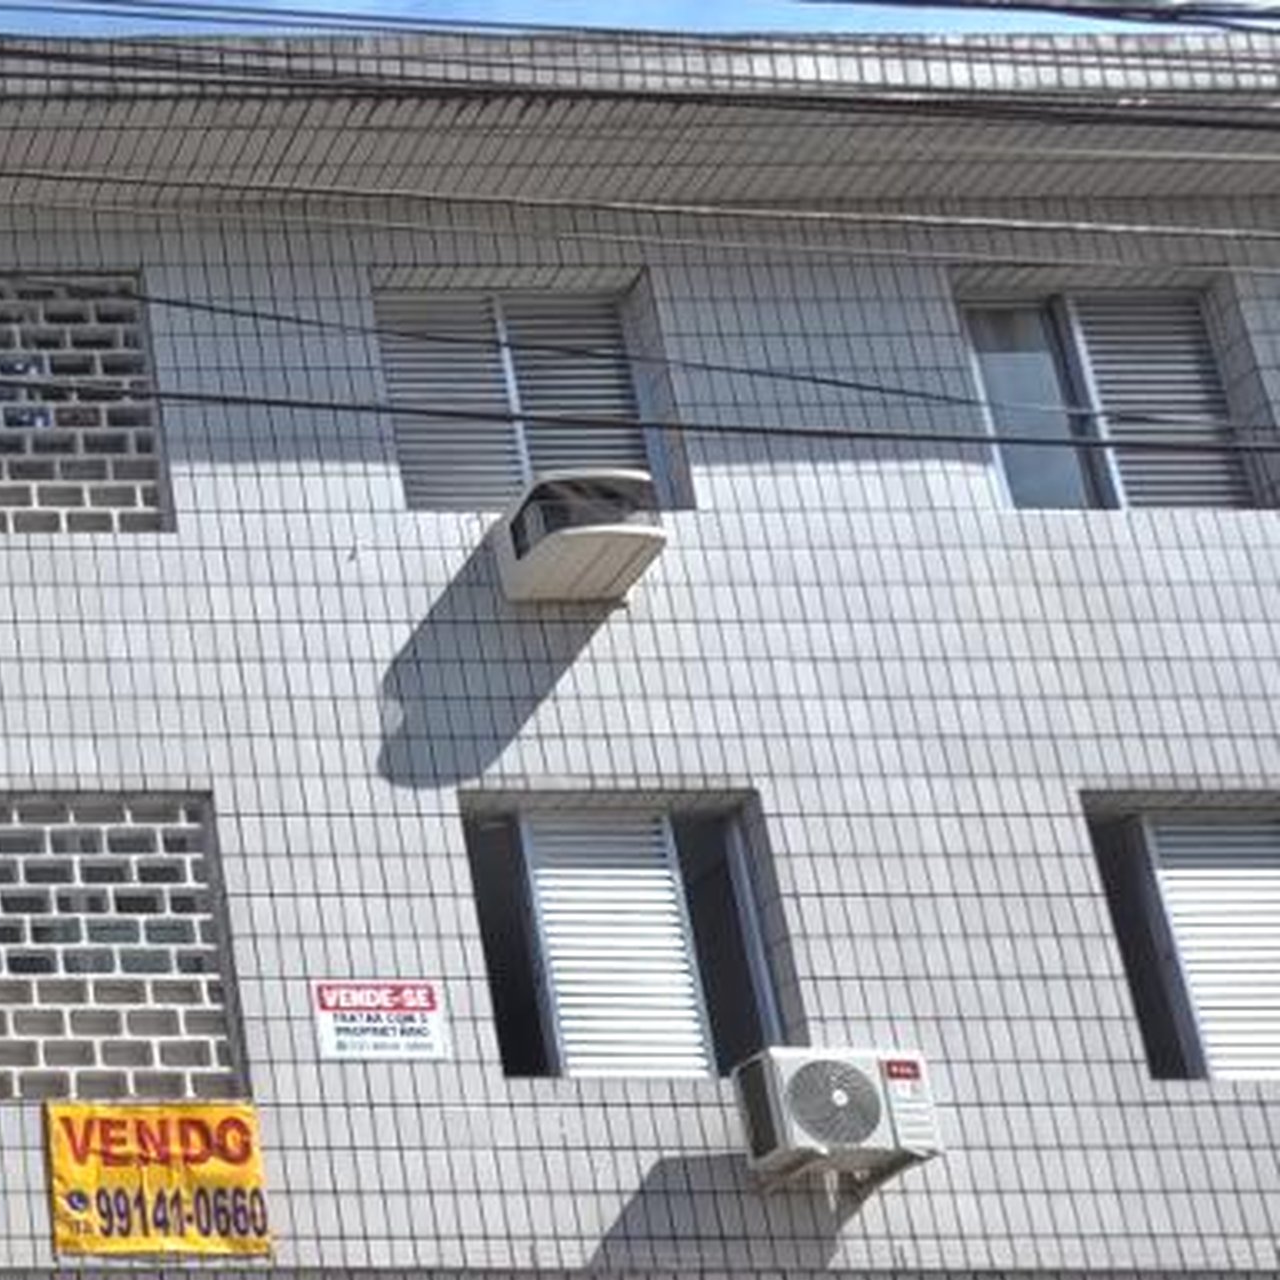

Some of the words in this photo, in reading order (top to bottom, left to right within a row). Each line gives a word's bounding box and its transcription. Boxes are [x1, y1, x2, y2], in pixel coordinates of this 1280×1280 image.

[322, 988, 432, 1008] VENDE-SE
[58, 1116, 252, 1167] VENDO
[94, 1186, 269, 1238] 99141-0660
